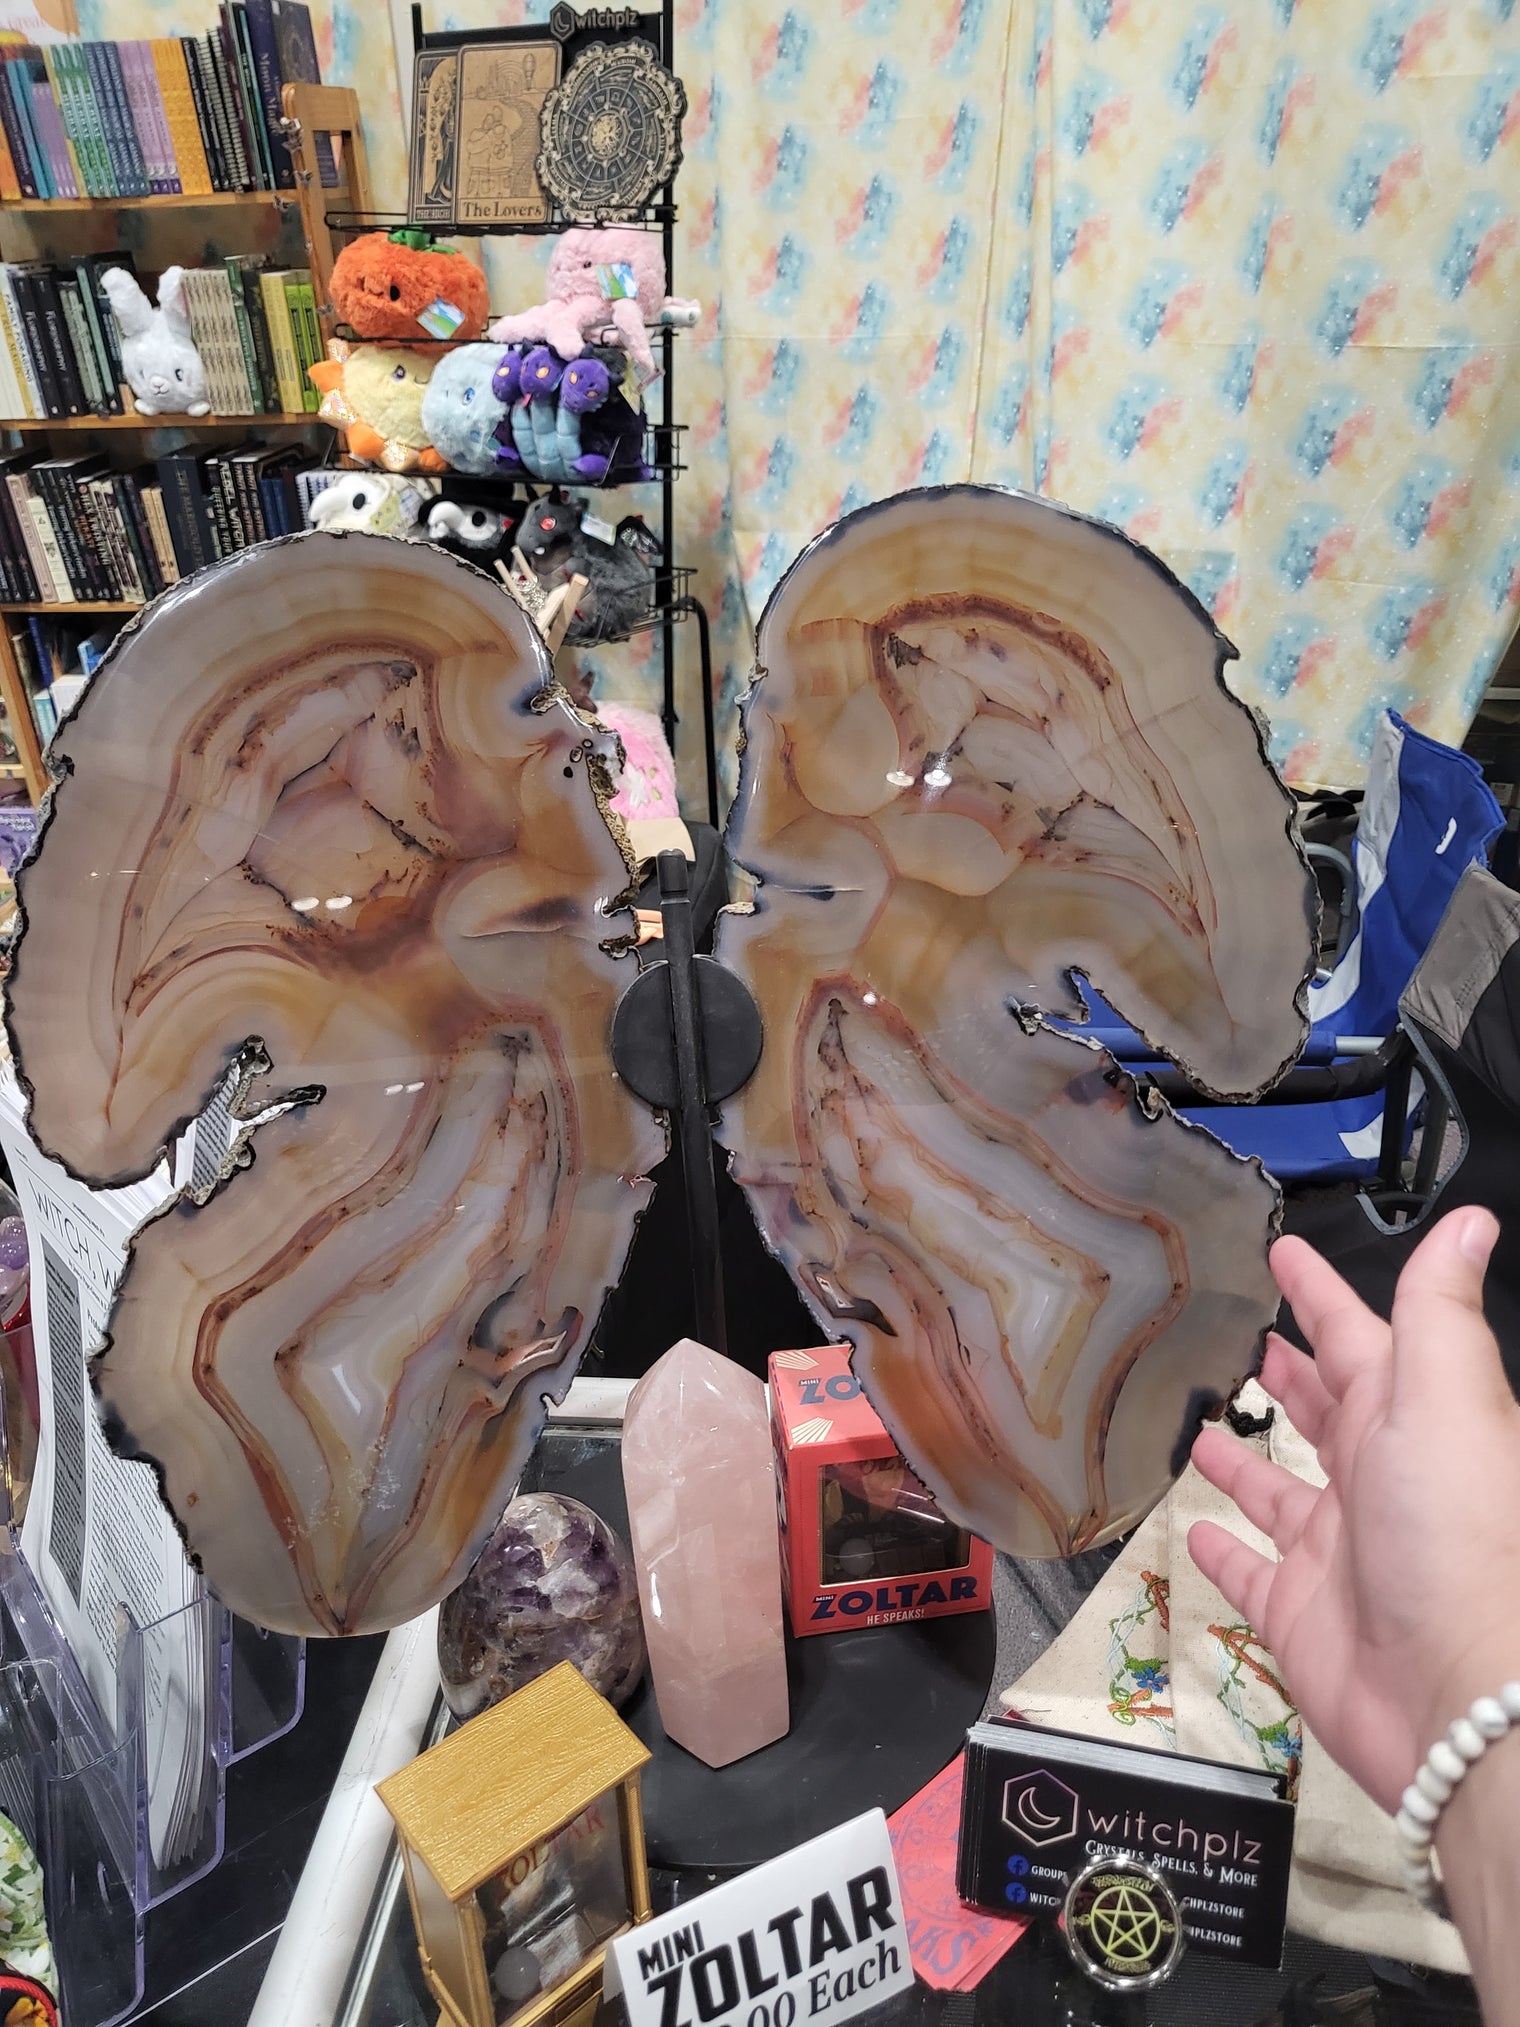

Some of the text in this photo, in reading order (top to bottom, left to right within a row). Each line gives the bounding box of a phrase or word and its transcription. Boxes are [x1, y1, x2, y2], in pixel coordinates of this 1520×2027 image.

[573, 6, 637, 31] witchplz
[257, 52, 274, 92] Moon
[463, 200, 542, 217] The Lovers
[217, 460, 246, 549] REBEL WITCH
[28, 1178, 96, 1280] WITCH,
[811, 1576, 977, 1620] ZOLTAR
[815, 1594, 835, 1602] MINI
[866, 1608, 925, 1626] HE SPEAKS!
[1087, 1808, 1263, 1865] witchplz
[1151, 1852, 1198, 1877] SPELLS,
[1203, 1862, 1214, 1879] &
[1218, 1865, 1259, 1887] MORE
[1181, 1895, 1246, 1919] CHPLZSTORE
[636, 1919, 706, 1982] MINI
[646, 1864, 898, 2027] ZOLTAR
[807, 1938, 903, 2019] Each
